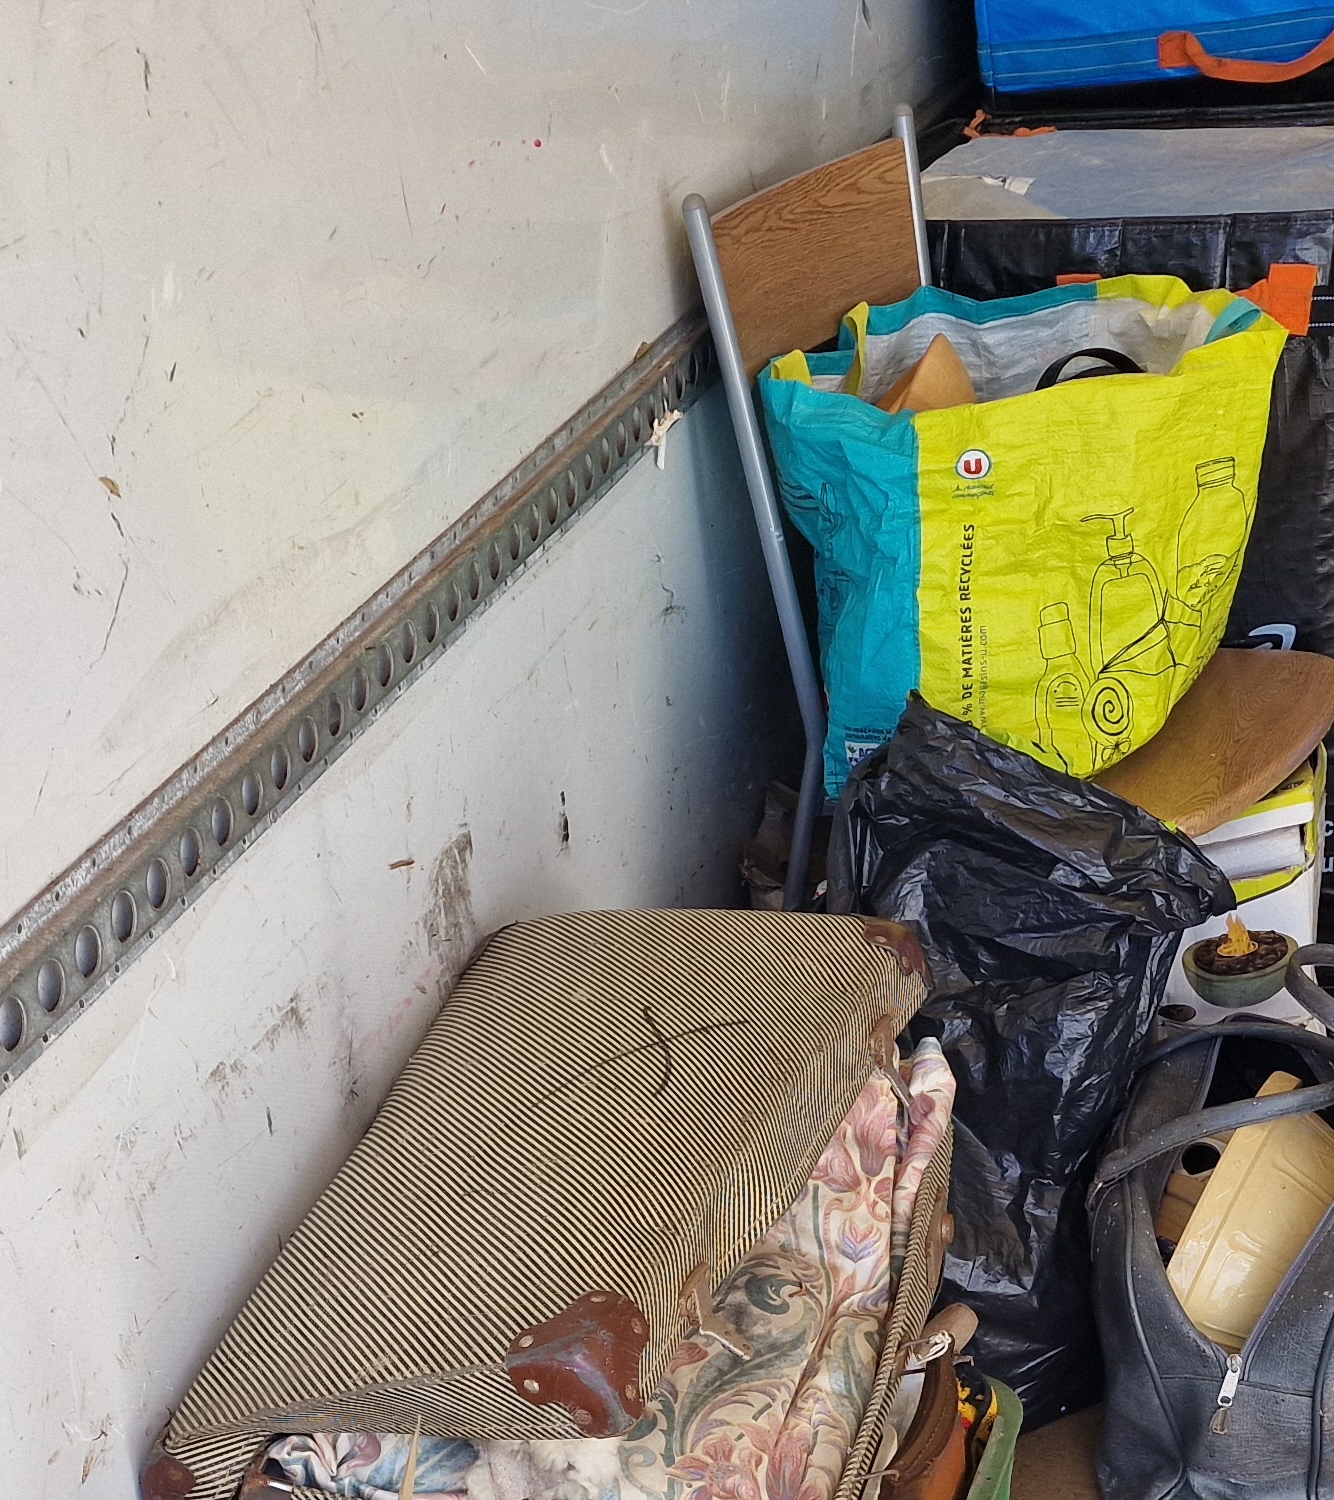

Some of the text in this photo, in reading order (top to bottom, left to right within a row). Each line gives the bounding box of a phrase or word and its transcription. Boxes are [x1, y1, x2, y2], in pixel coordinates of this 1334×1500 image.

[959, 524, 975, 601] RECYCLÉES
[958, 607, 973, 678] MATIÈRES
[962, 683, 973, 701] DE
